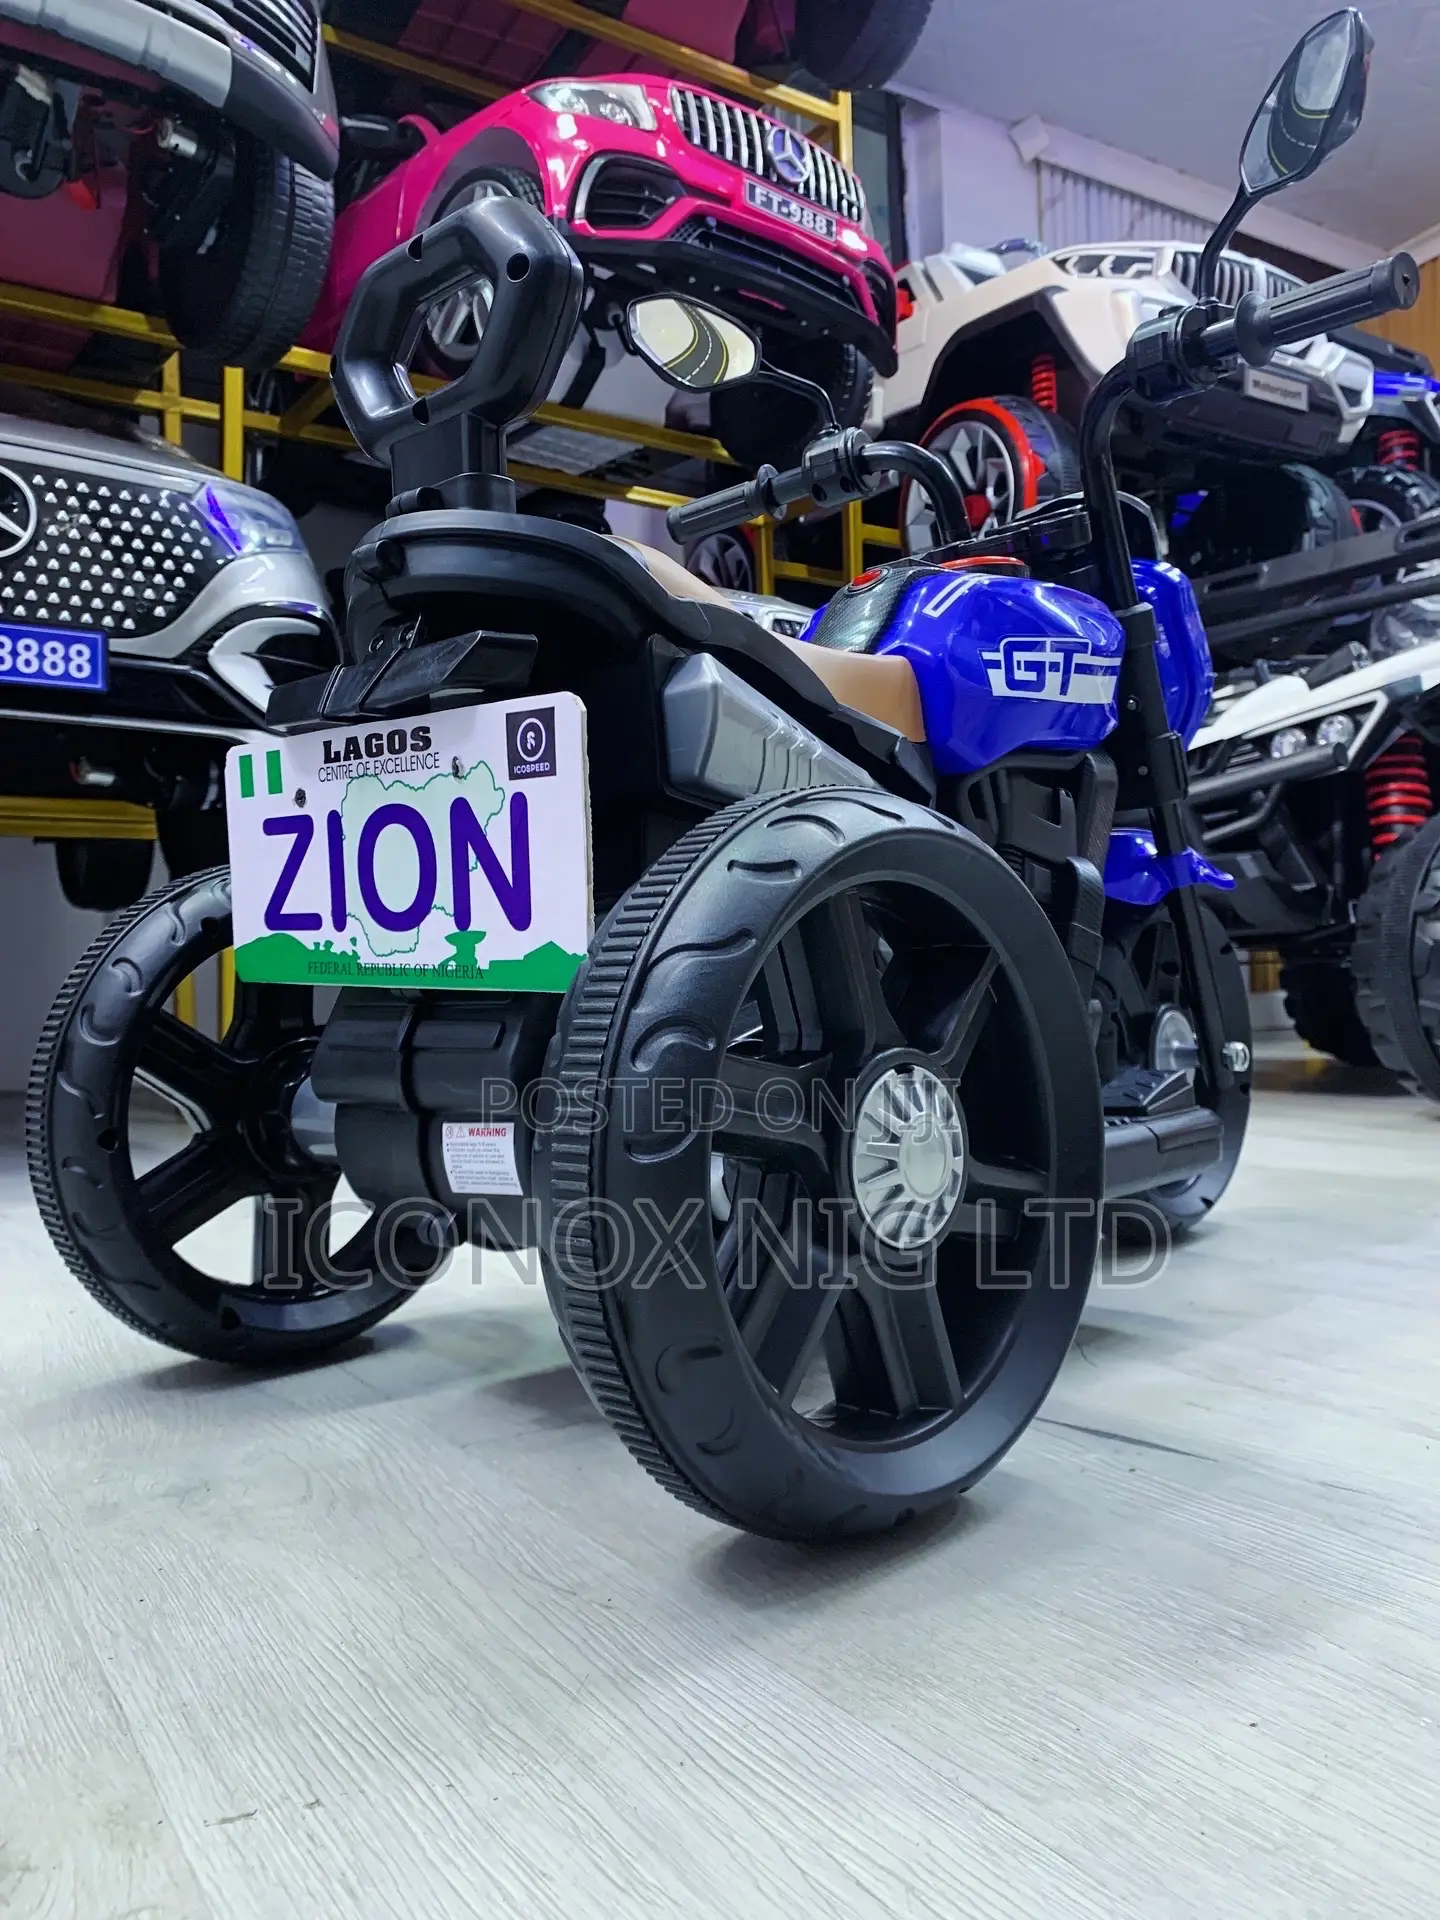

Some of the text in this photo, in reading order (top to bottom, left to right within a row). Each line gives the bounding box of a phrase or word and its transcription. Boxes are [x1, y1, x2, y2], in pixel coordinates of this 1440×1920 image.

[755, 186, 827, 234] FT-988
[1000, 637, 1091, 696] GT
[322, 725, 432, 765] LAGOS
[317, 751, 441, 783] CENTRE OF EXCELLENCE
[513, 761, 551, 775] ICOSPEED
[262, 791, 532, 933] ZION
[307, 961, 485, 980] FEDERAL REPUBLIC OF NIGERIA
[468, 1127, 507, 1138] WARNING
